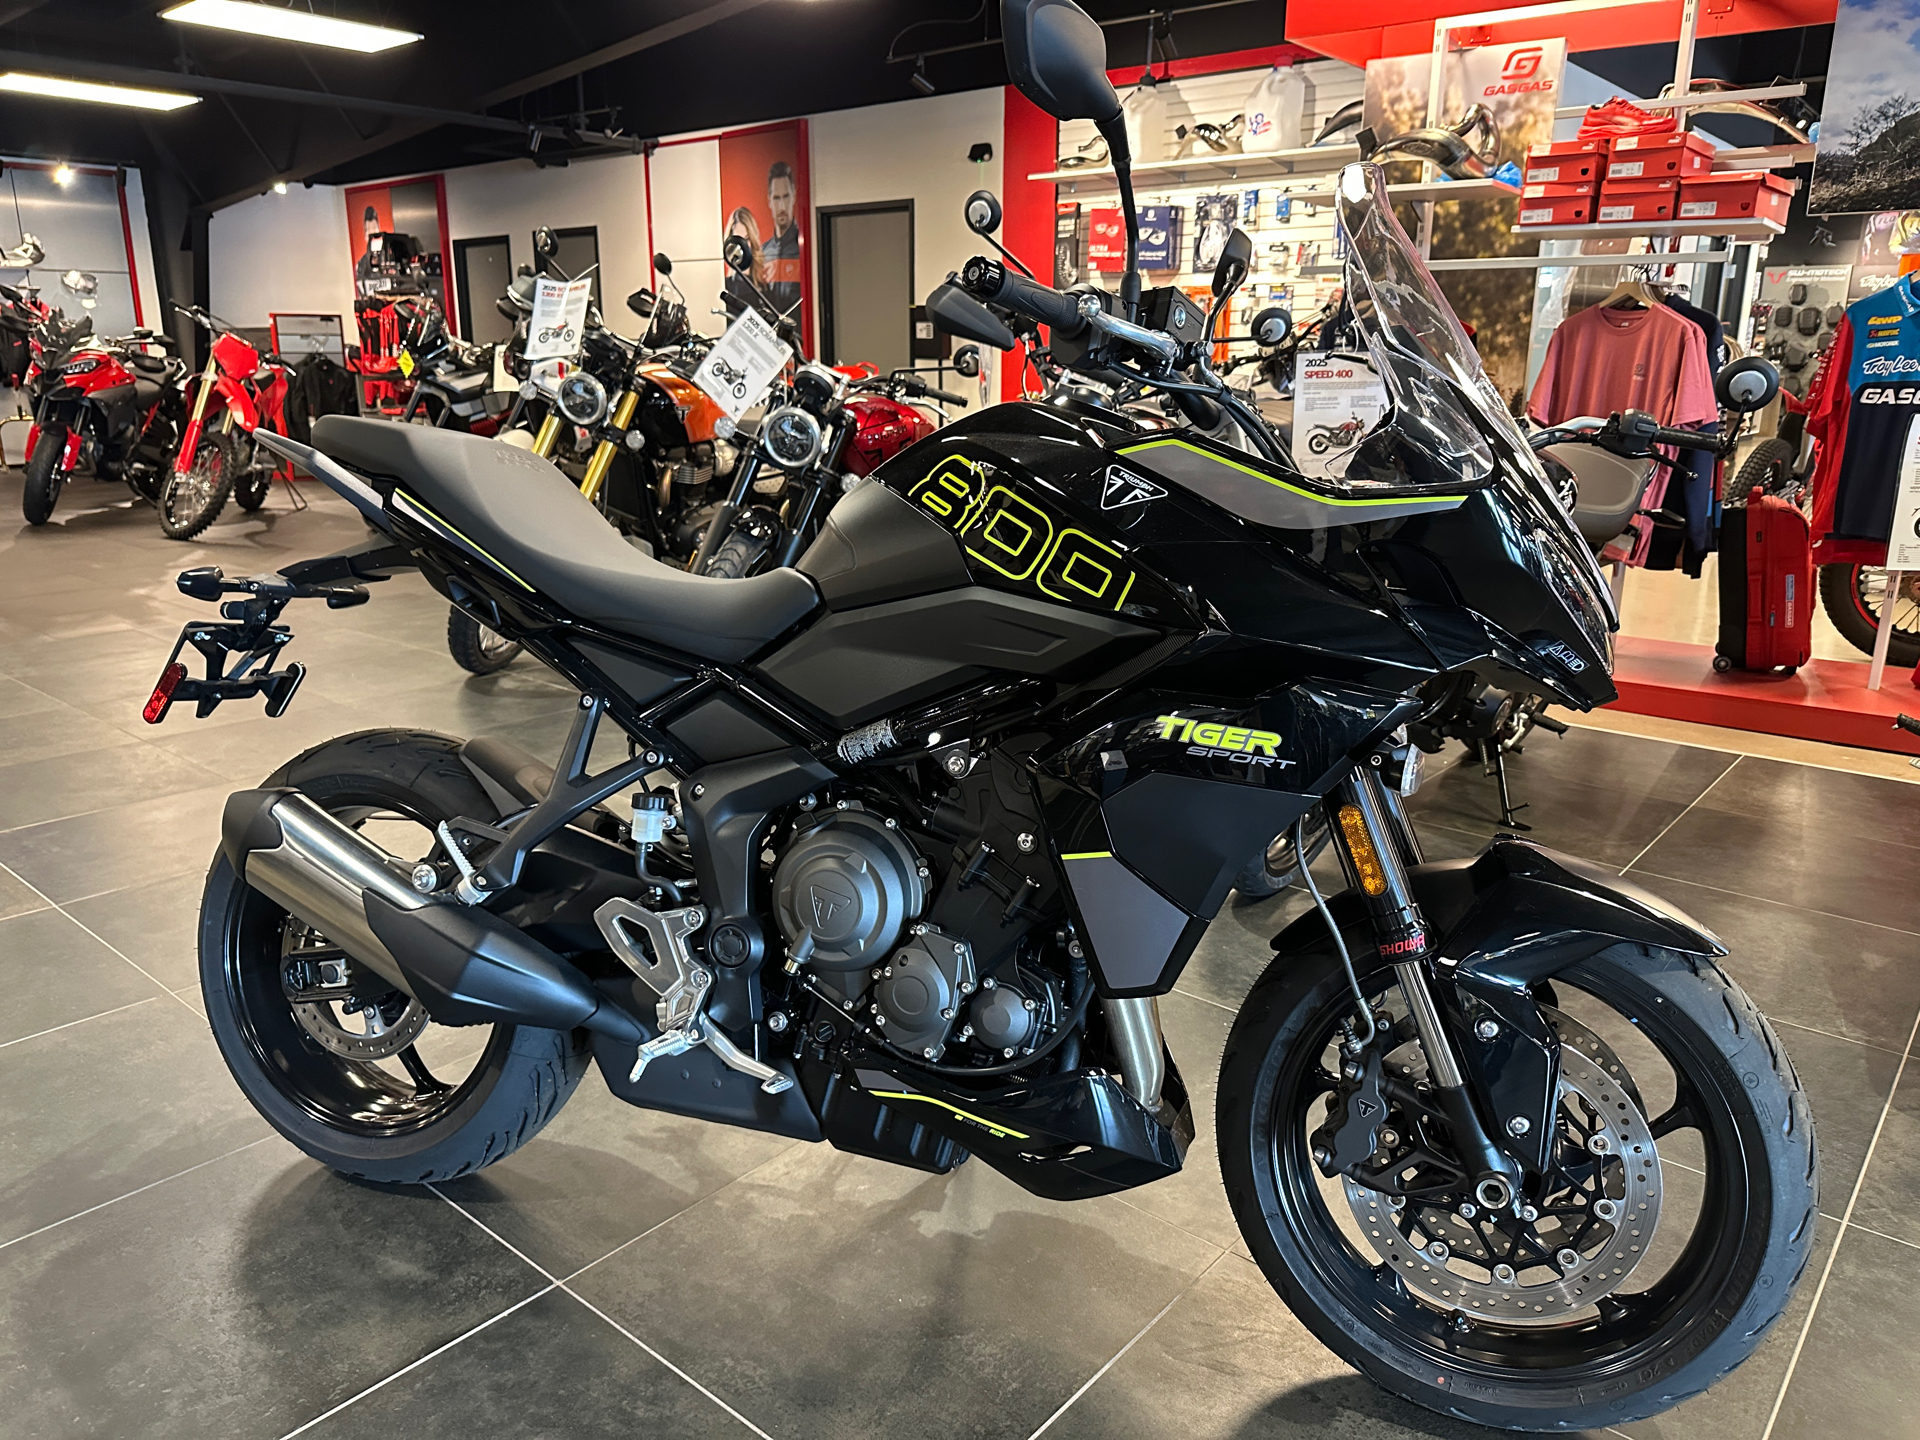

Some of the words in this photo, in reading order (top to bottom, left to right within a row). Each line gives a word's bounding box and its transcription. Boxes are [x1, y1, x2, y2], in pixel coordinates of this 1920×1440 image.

[1483, 80, 1554, 96] GASGAS
[1305, 358, 1328, 367] 2025
[1863, 356, 1893, 376] Troy
[1891, 355, 1917, 373] Lee
[1304, 370, 1334, 379] SPEED
[1335, 369, 1353, 378] 400
[1118, 470, 1154, 492] TRIUMPH
[908, 454, 1136, 611] 800
[1155, 715, 1282, 757] TIGER
[1186, 746, 1296, 769] SPORT
[1380, 934, 1425, 956] SHOWA
[963, 1117, 977, 1126] FOR
[976, 1123, 989, 1132] THE
[988, 1128, 1006, 1138] RIDE
